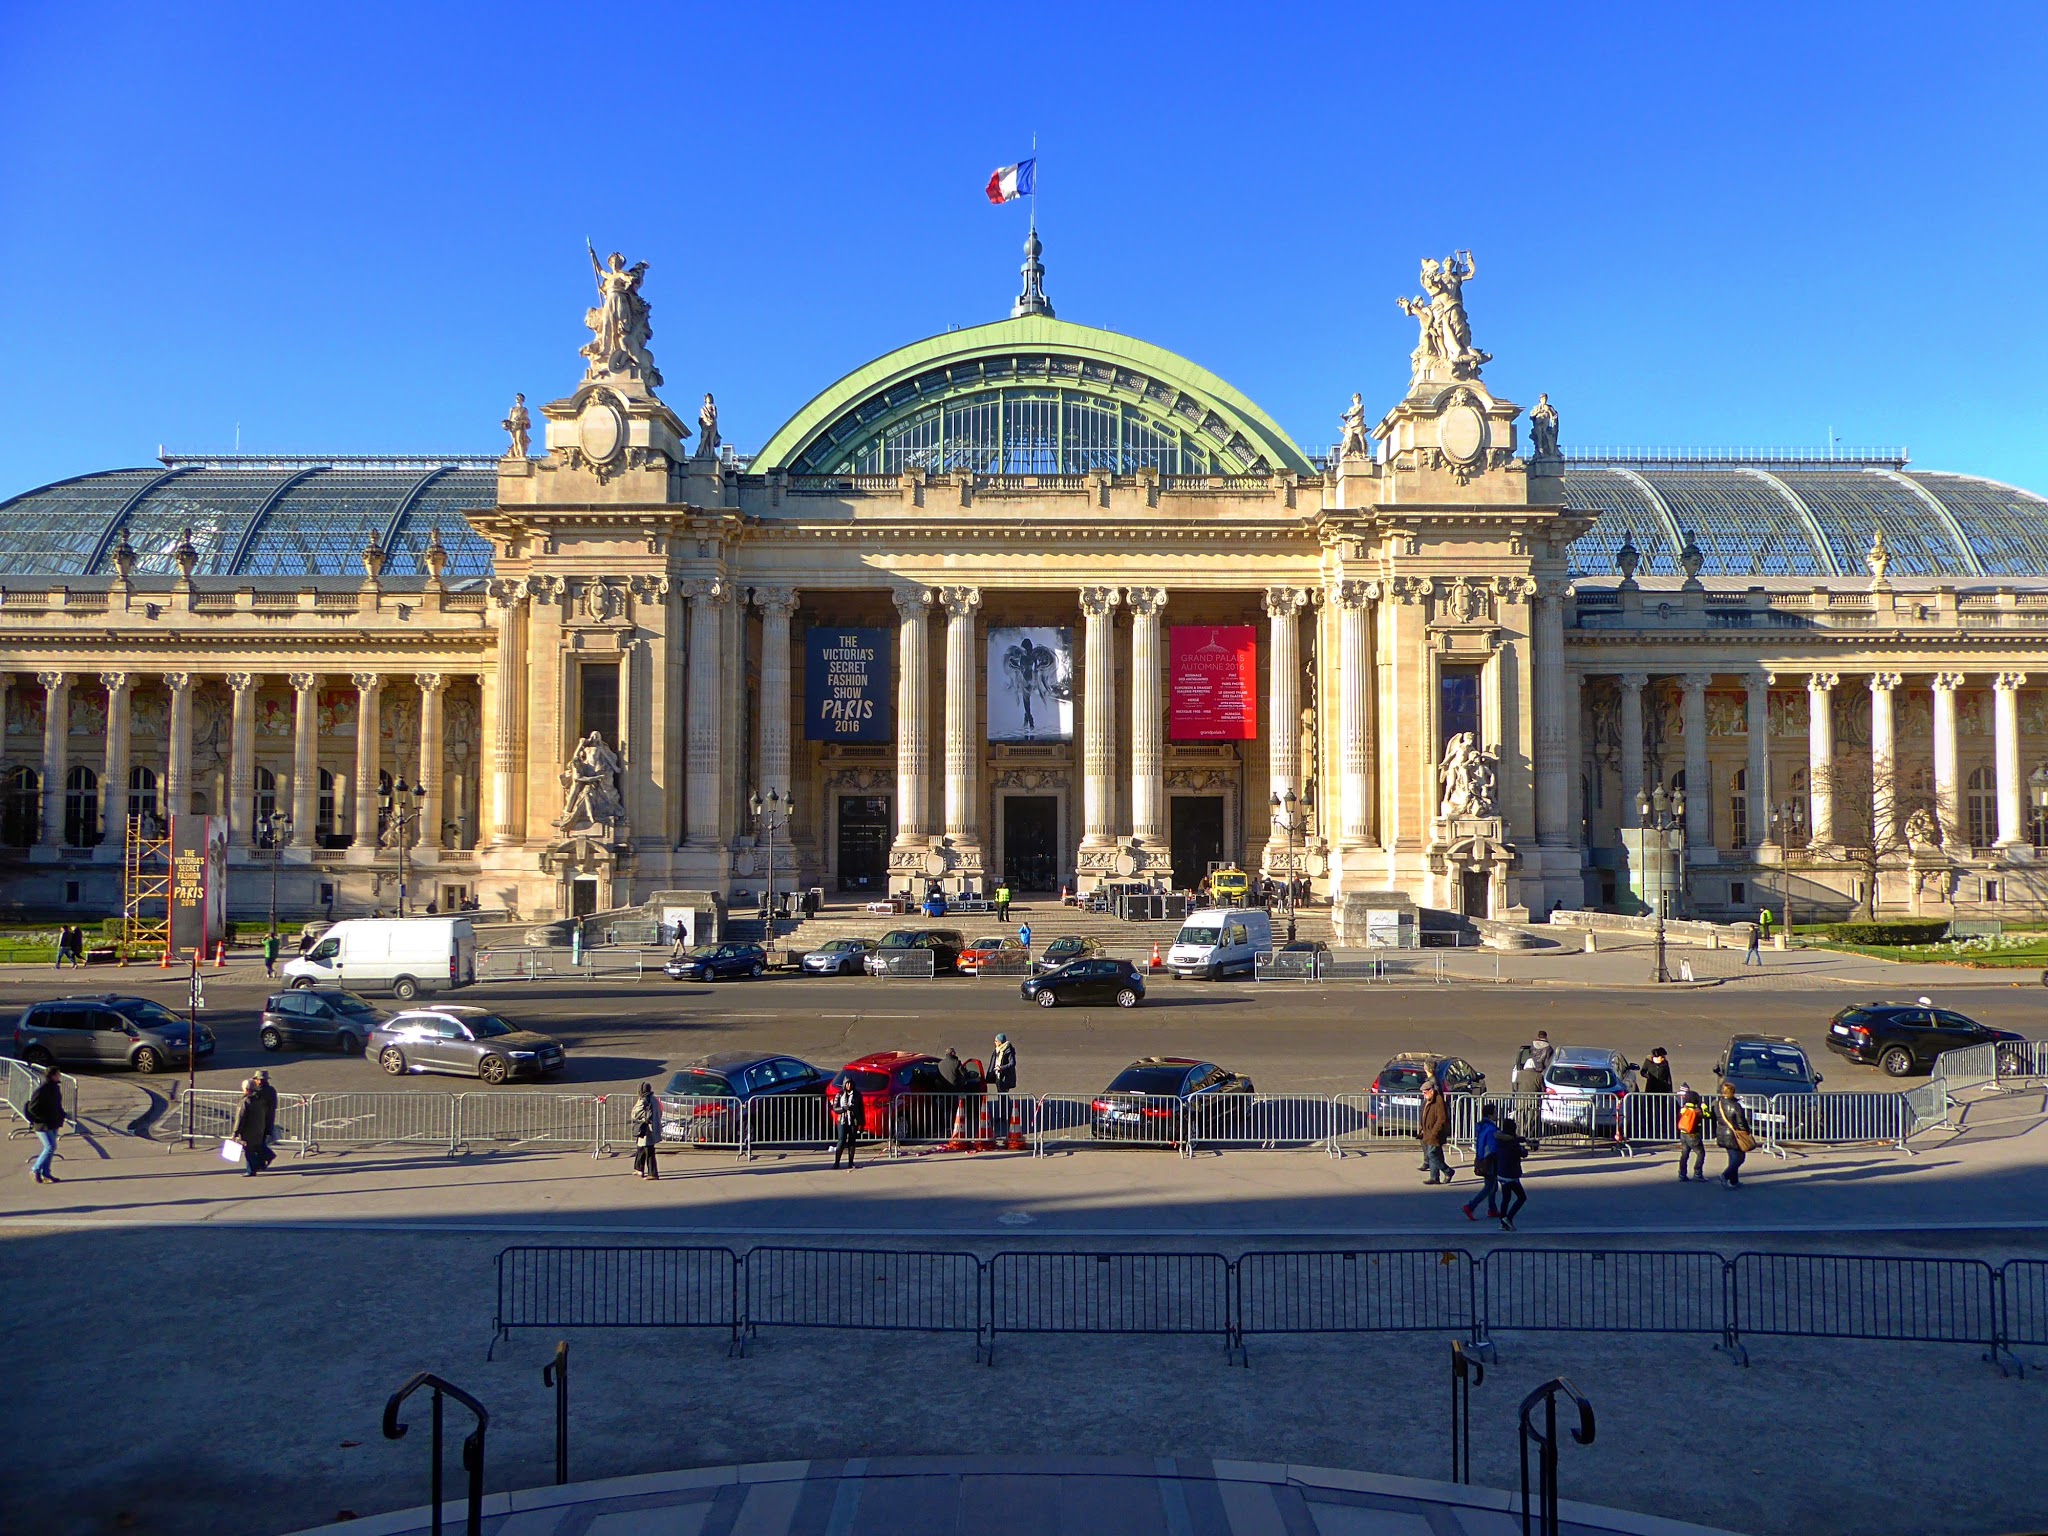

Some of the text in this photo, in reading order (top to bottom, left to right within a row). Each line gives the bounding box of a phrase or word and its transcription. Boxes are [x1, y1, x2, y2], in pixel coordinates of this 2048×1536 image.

[839, 636, 858, 648] THE
[823, 649, 874, 661] VICTORIA'S
[830, 662, 866, 674] SECRET
[1181, 663, 1245, 671] AUTOMNE 2016
[828, 674, 868, 686] FASHION
[833, 687, 862, 699] SHOW
[821, 699, 874, 720] PARIS
[835, 720, 860, 732] 2016
[184, 849, 195, 857] THE
[174, 857, 205, 865] VICTORIA'S
[178, 864, 201, 872] SECRET
[180, 879, 198, 887] SHOW
[173, 886, 204, 899] PARIS
[181, 899, 196, 907] 2016
